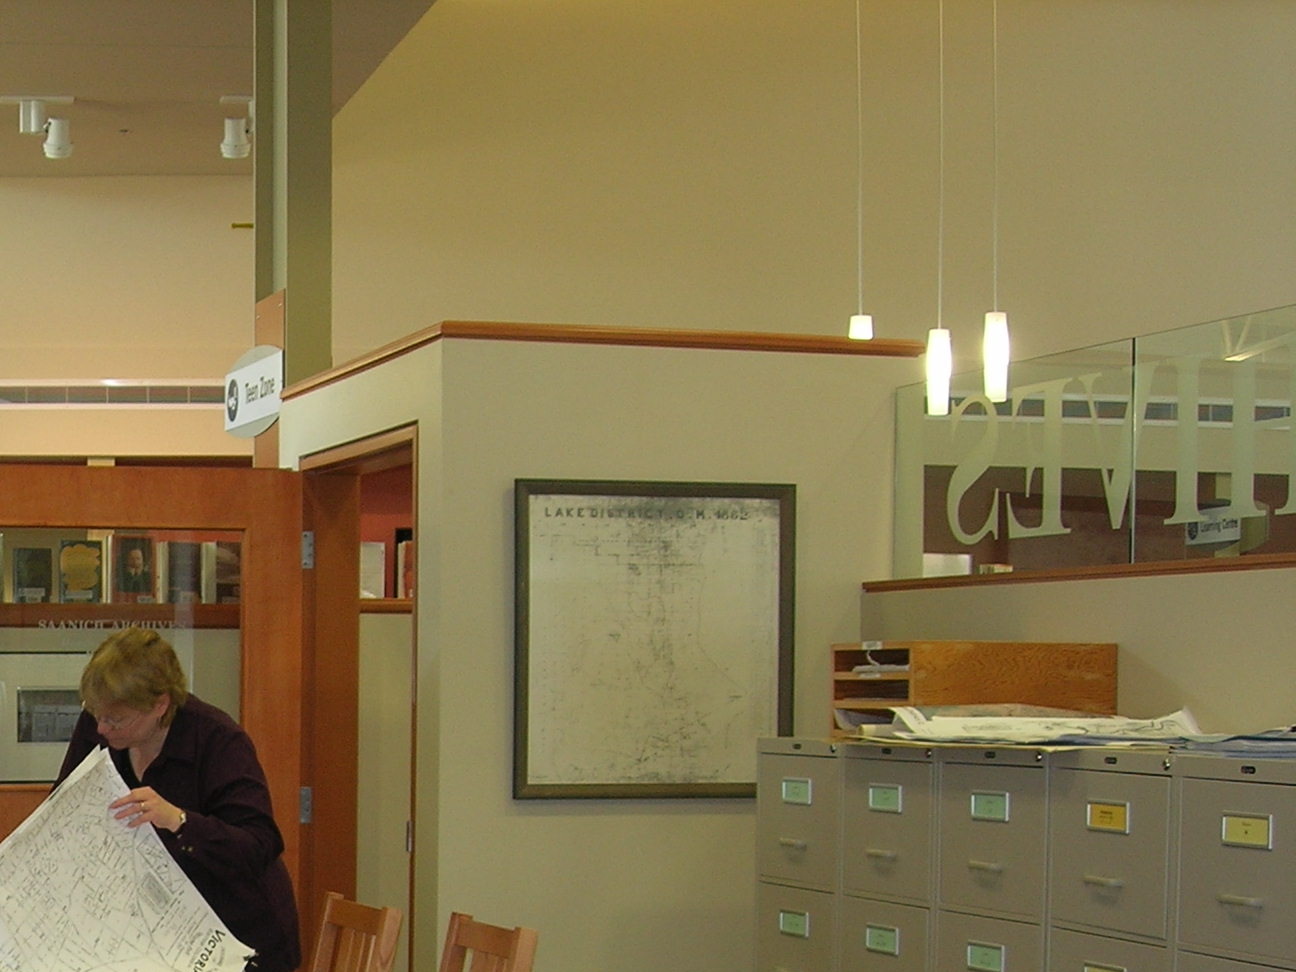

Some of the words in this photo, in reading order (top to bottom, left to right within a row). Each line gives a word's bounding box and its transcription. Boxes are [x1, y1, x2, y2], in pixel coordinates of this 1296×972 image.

[245, 382, 259, 404] Teen
[260, 376, 275, 398] Zone
[544, 507, 585, 518] LAKE
[38, 620, 104, 630] SAANICH
